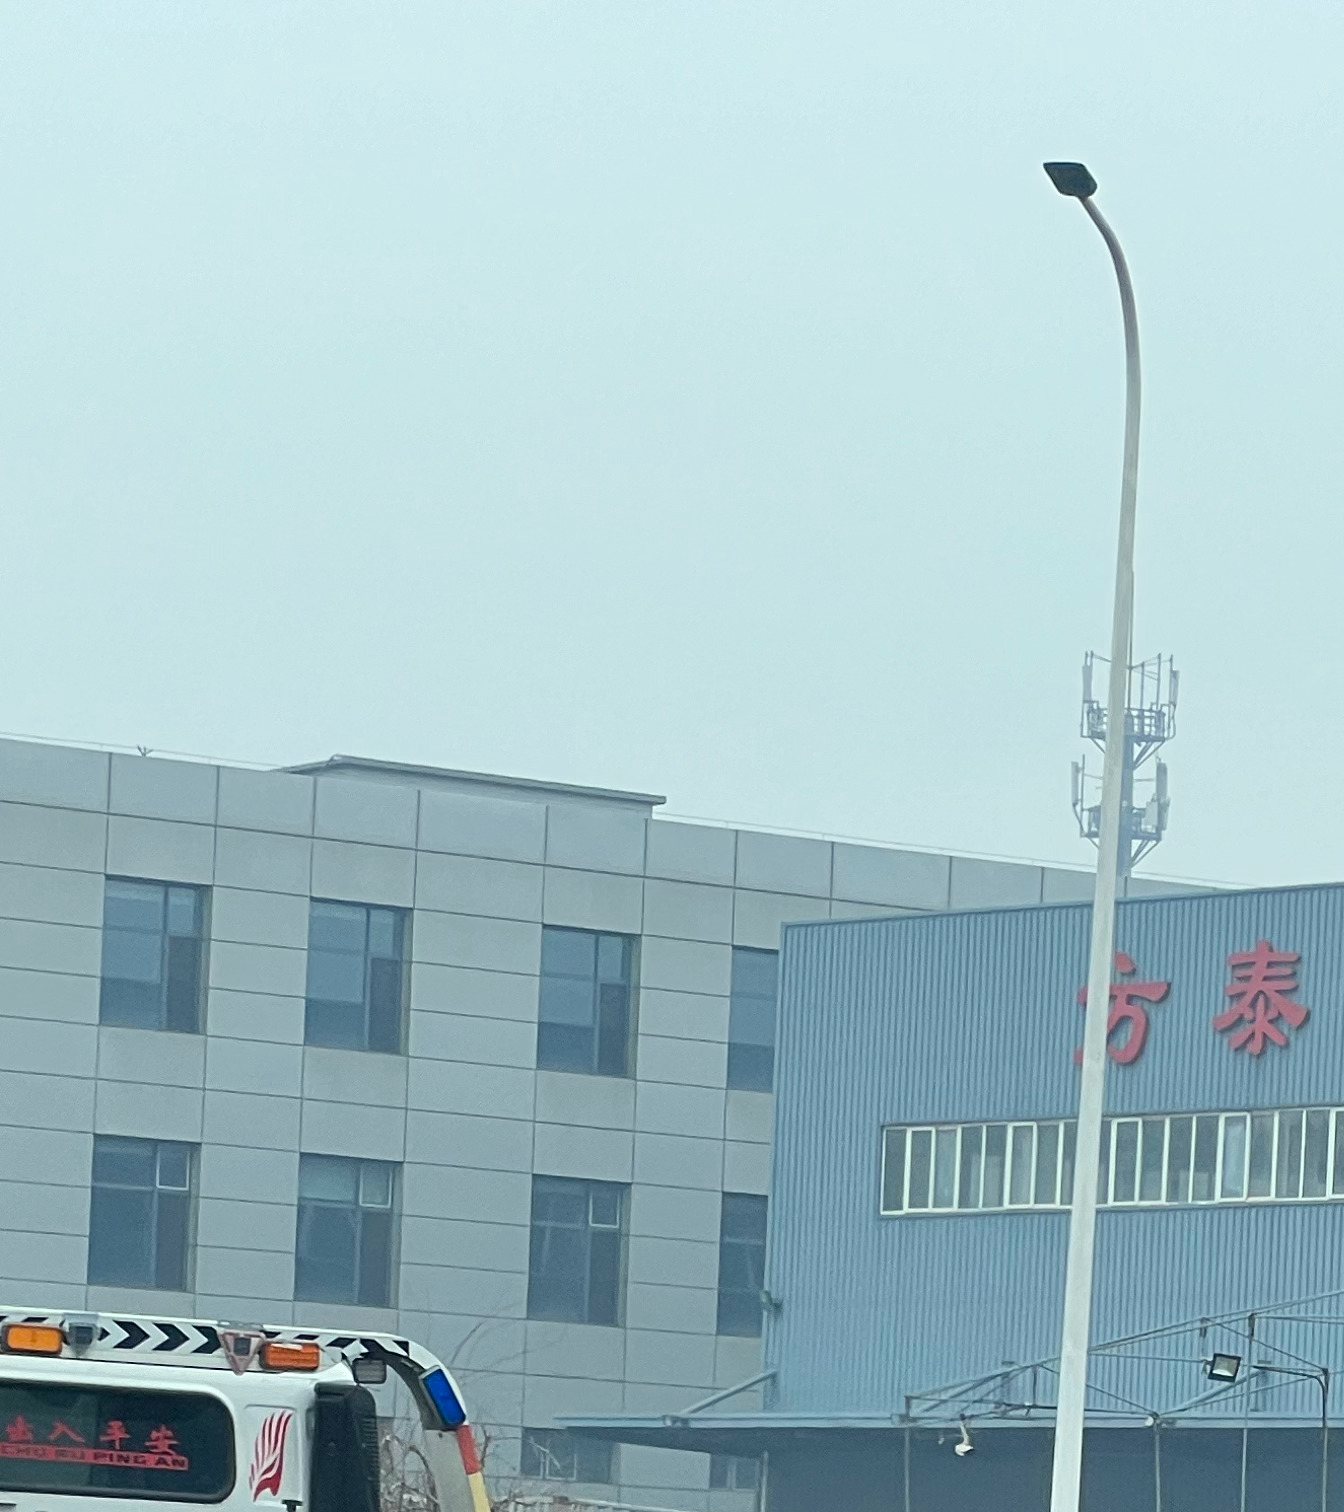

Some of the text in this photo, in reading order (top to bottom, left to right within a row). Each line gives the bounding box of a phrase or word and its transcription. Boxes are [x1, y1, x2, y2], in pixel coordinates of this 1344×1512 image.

[6, 1415, 180, 1456] 出入平安
[155, 1454, 187, 1468] AN
